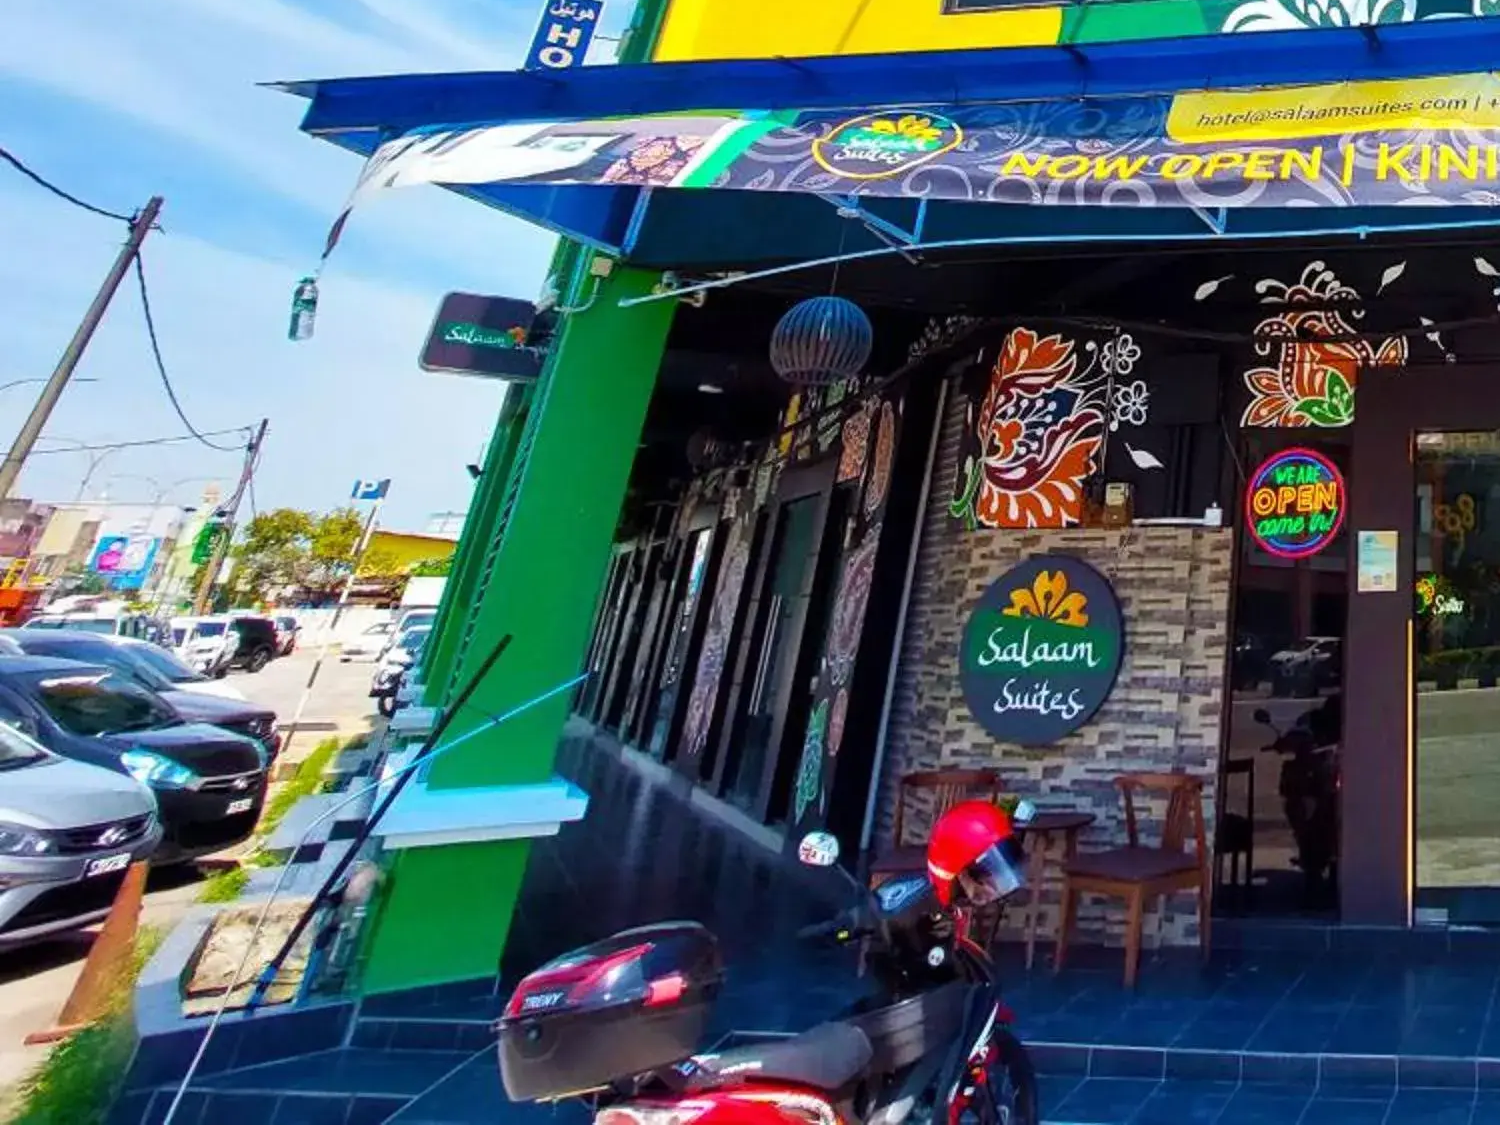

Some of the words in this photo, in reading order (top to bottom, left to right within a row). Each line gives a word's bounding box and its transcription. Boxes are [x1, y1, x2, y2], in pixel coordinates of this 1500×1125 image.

[1000, 150, 1151, 180] NOW
[1159, 145, 1324, 181] OPEN
[1375, 142, 1499, 182] KINI
[356, 480, 378, 499] P
[1274, 466, 1297, 484] WE
[1253, 482, 1337, 516] OPEN
[1257, 515, 1304, 537] come
[978, 625, 1100, 667] Salaam
[993, 677, 1084, 719] Suites
